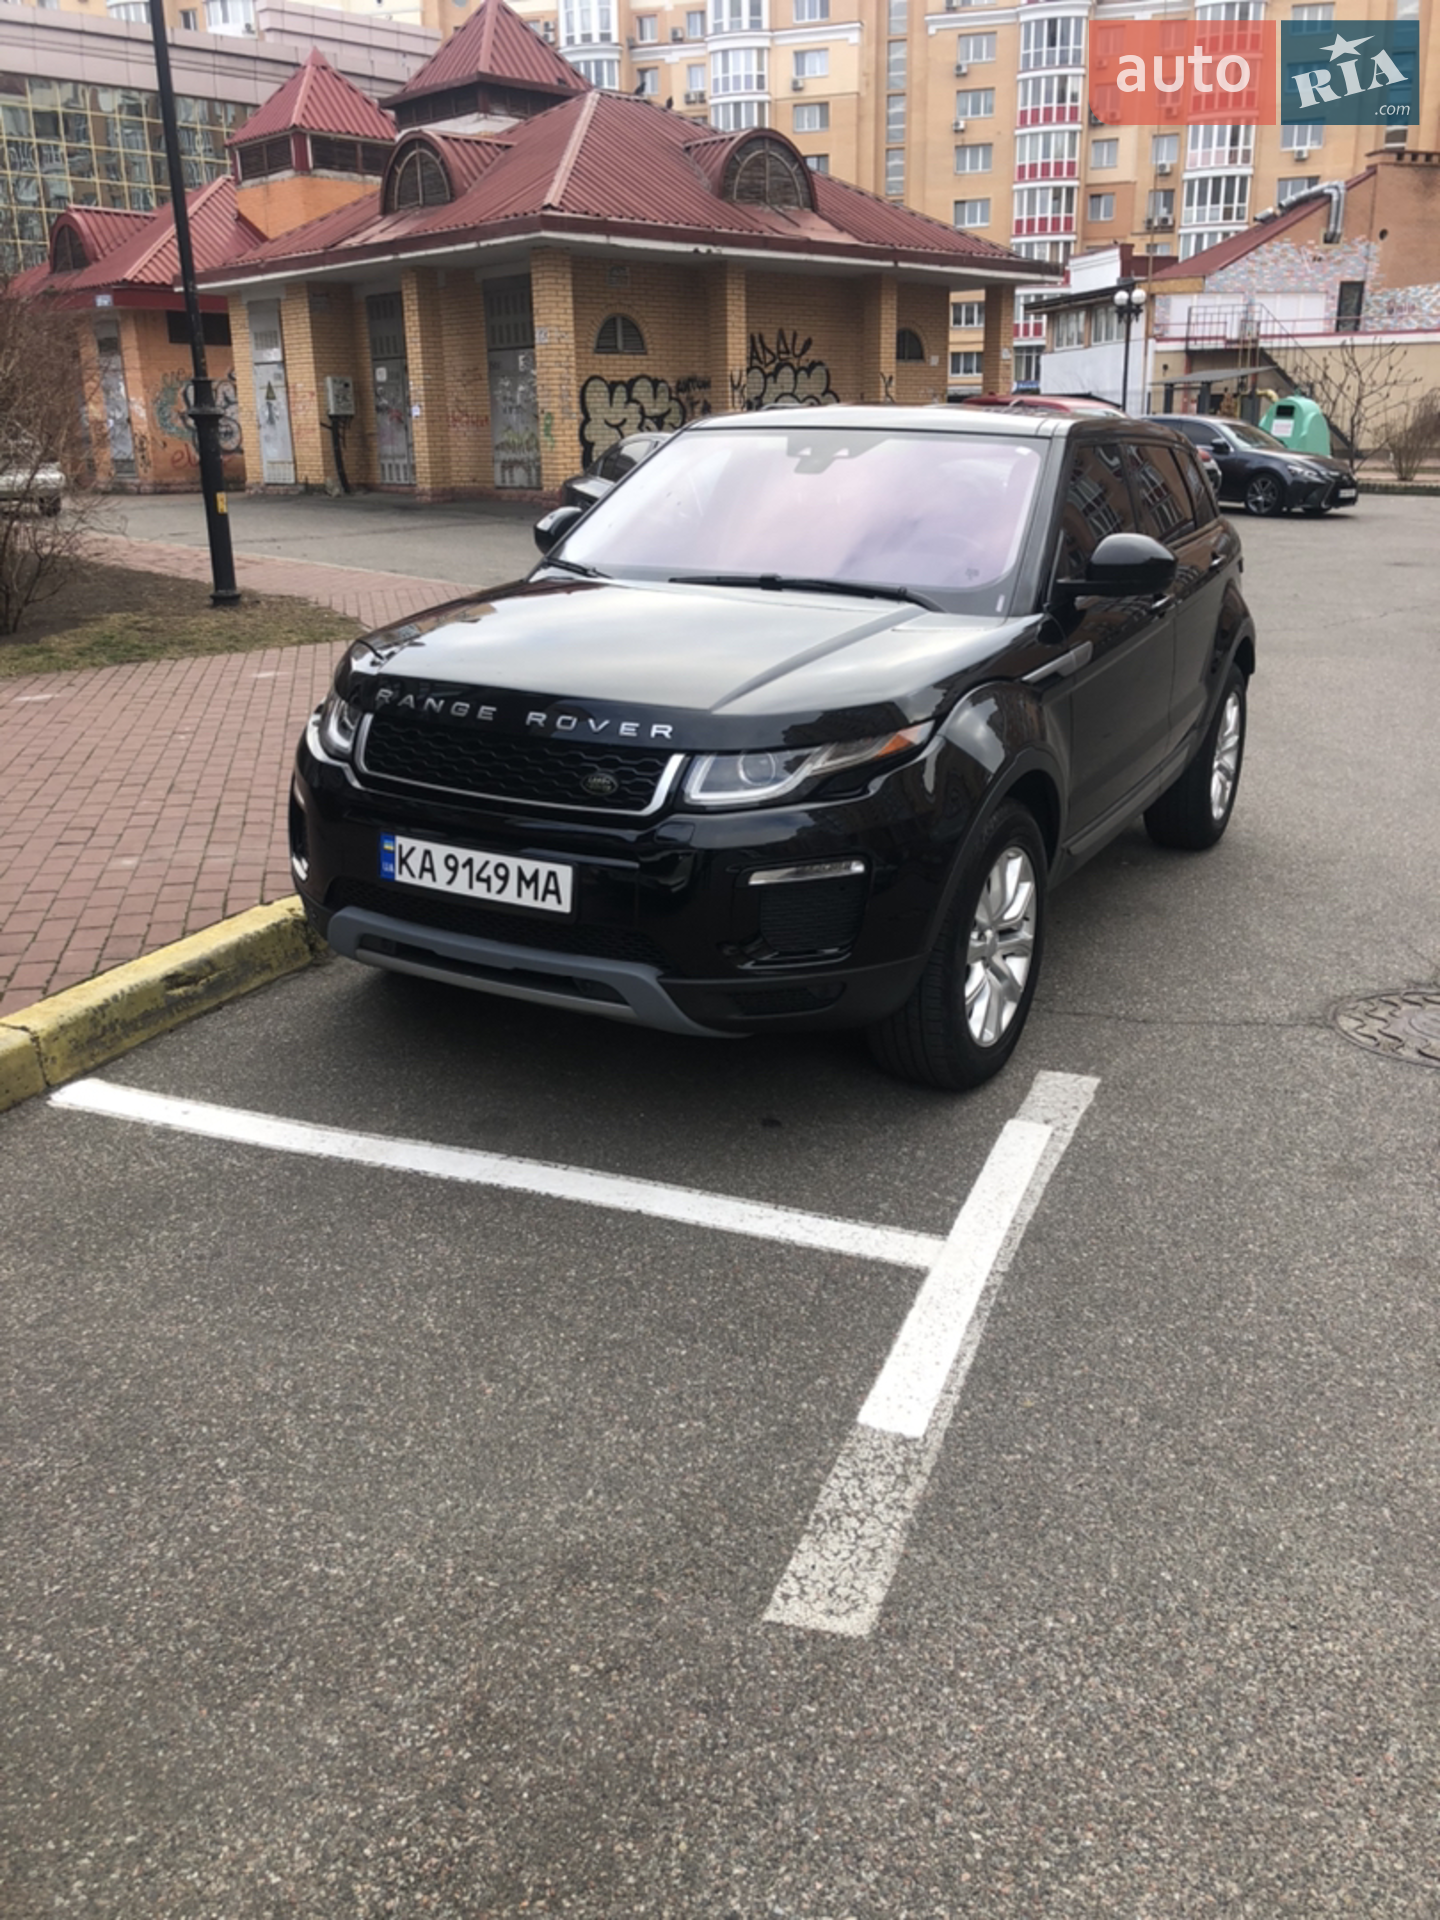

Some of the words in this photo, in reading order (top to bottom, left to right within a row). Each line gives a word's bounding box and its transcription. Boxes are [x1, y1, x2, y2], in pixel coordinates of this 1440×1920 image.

[376, 688, 497, 721] RANGE
[525, 711, 674, 740] ROVER
[398, 843, 437, 883] KA
[444, 853, 510, 895] 9149
[516, 864, 562, 906] MA
